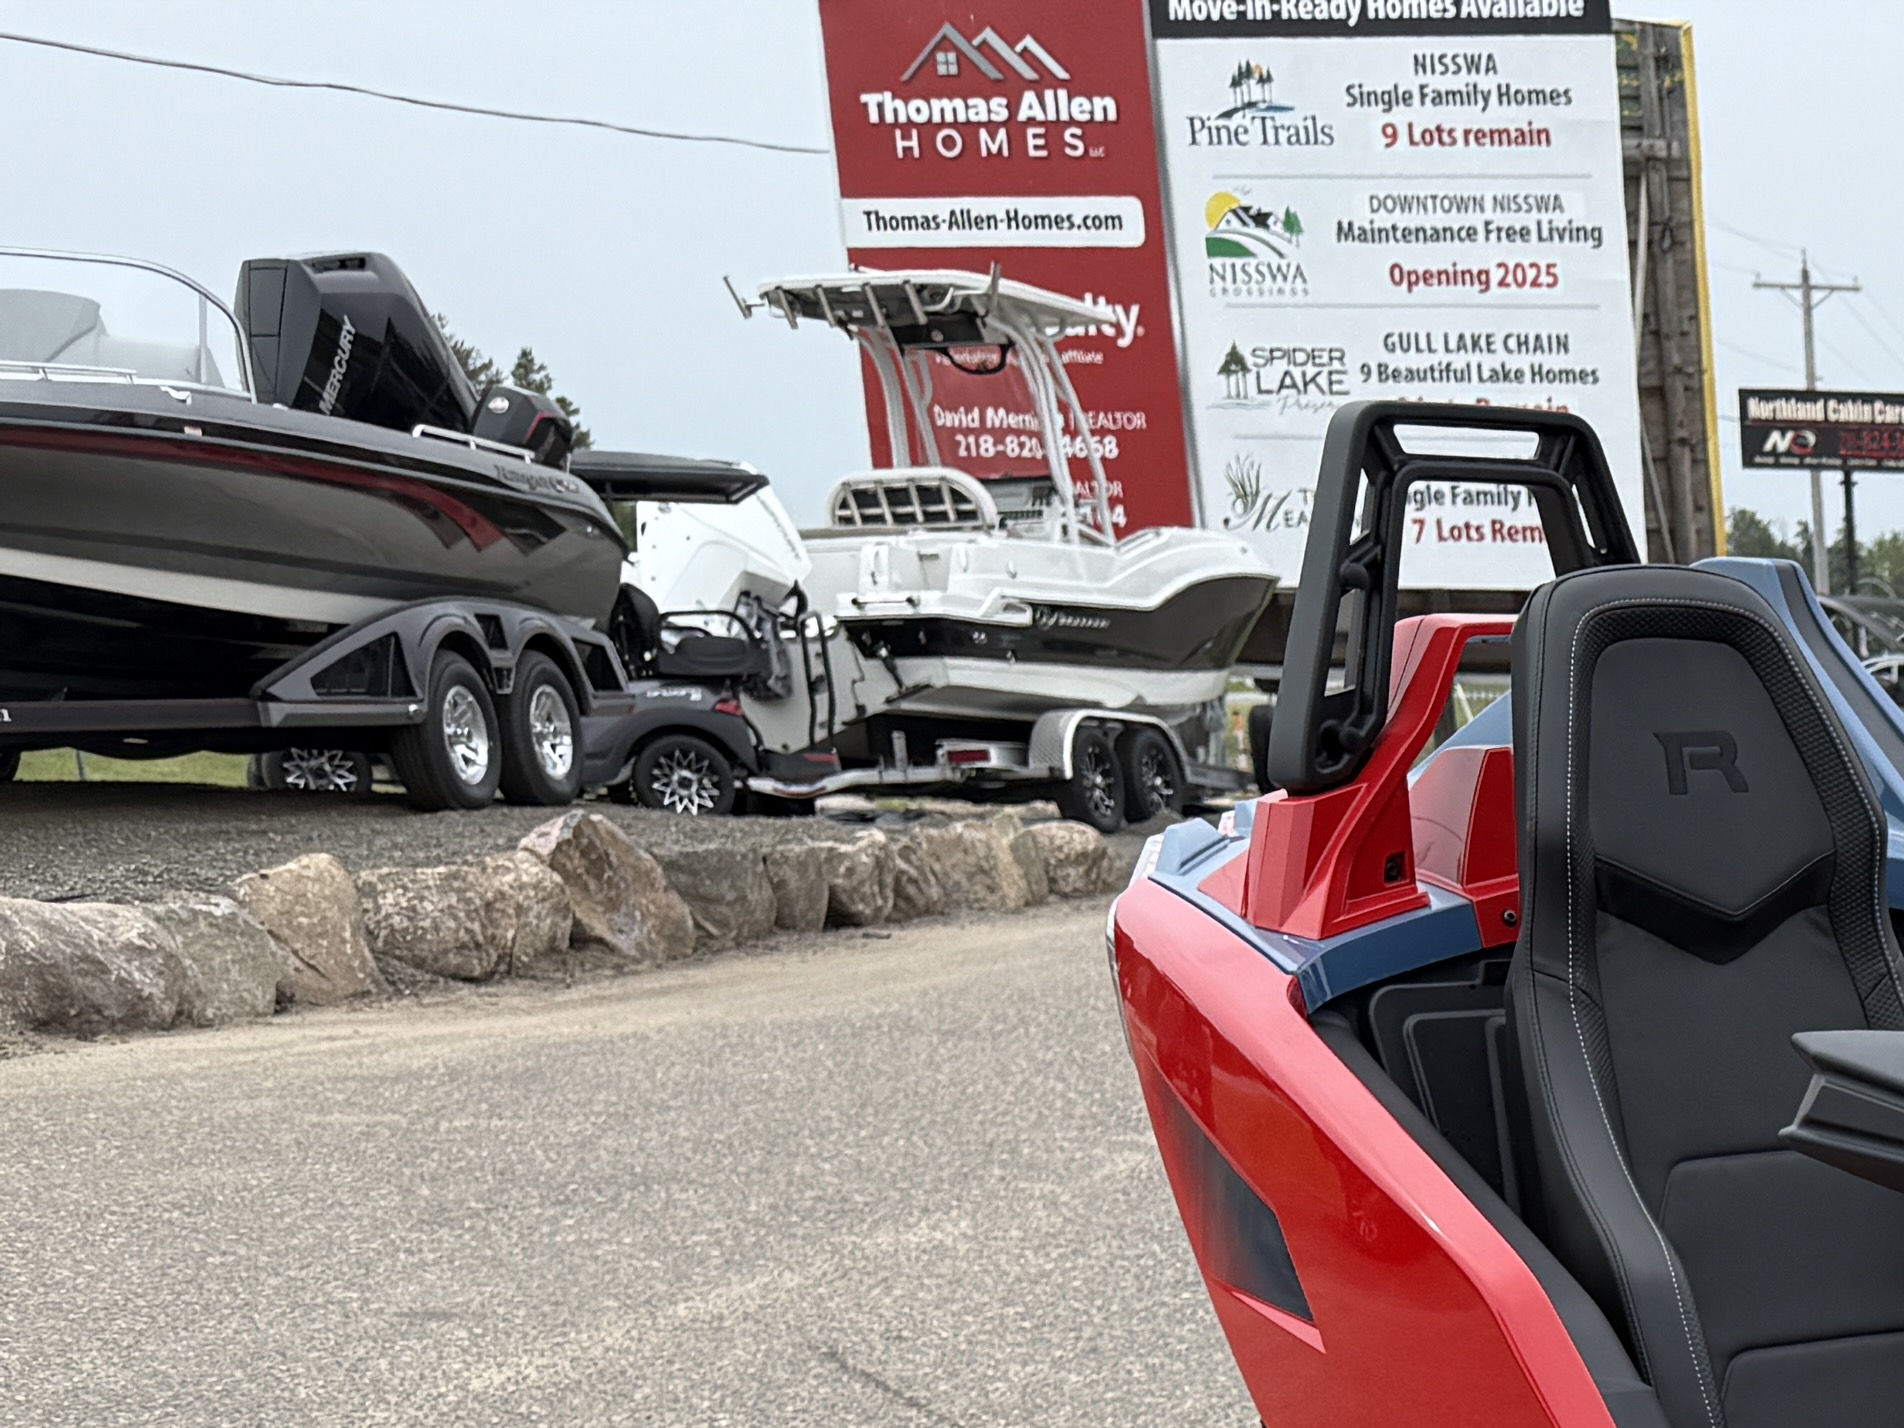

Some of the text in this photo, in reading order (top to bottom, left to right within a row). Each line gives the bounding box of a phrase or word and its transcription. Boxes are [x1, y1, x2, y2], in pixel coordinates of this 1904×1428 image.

[1368, 0, 1457, 19] Homes
[1460, 0, 1585, 18] Available
[1413, 53, 1498, 77] NISSWA
[860, 88, 1118, 124] Thomas Allen
[1345, 83, 1573, 113] Single Family Homes
[894, 127, 1085, 159] HOMES
[1186, 115, 1335, 148] Pine Trails
[1381, 122, 1552, 148] 9 Lots remain
[1369, 194, 1565, 215] DOWNTOWN NISSWA
[862, 208, 1123, 232] Thomas-Allen-Homes.com
[1336, 220, 1604, 248] Maintenance Free Living
[1208, 263, 1308, 286] NISSWA
[1389, 262, 1560, 293] Opening 2025
[1250, 346, 1346, 368] SPIDER
[1383, 332, 1570, 356] GULL LAKE CHAIN
[319, 315, 356, 415] MERCURY
[1359, 362, 1600, 386] 9 Beautiful Lake Homes
[1255, 369, 1350, 396] LAKE
[933, 404, 980, 428] David
[955, 434, 1119, 459] 218-8204668
[1451, 485, 1522, 512] Family
[1411, 518, 1545, 544] 7 Lots Rem
[1652, 729, 1750, 796] R
